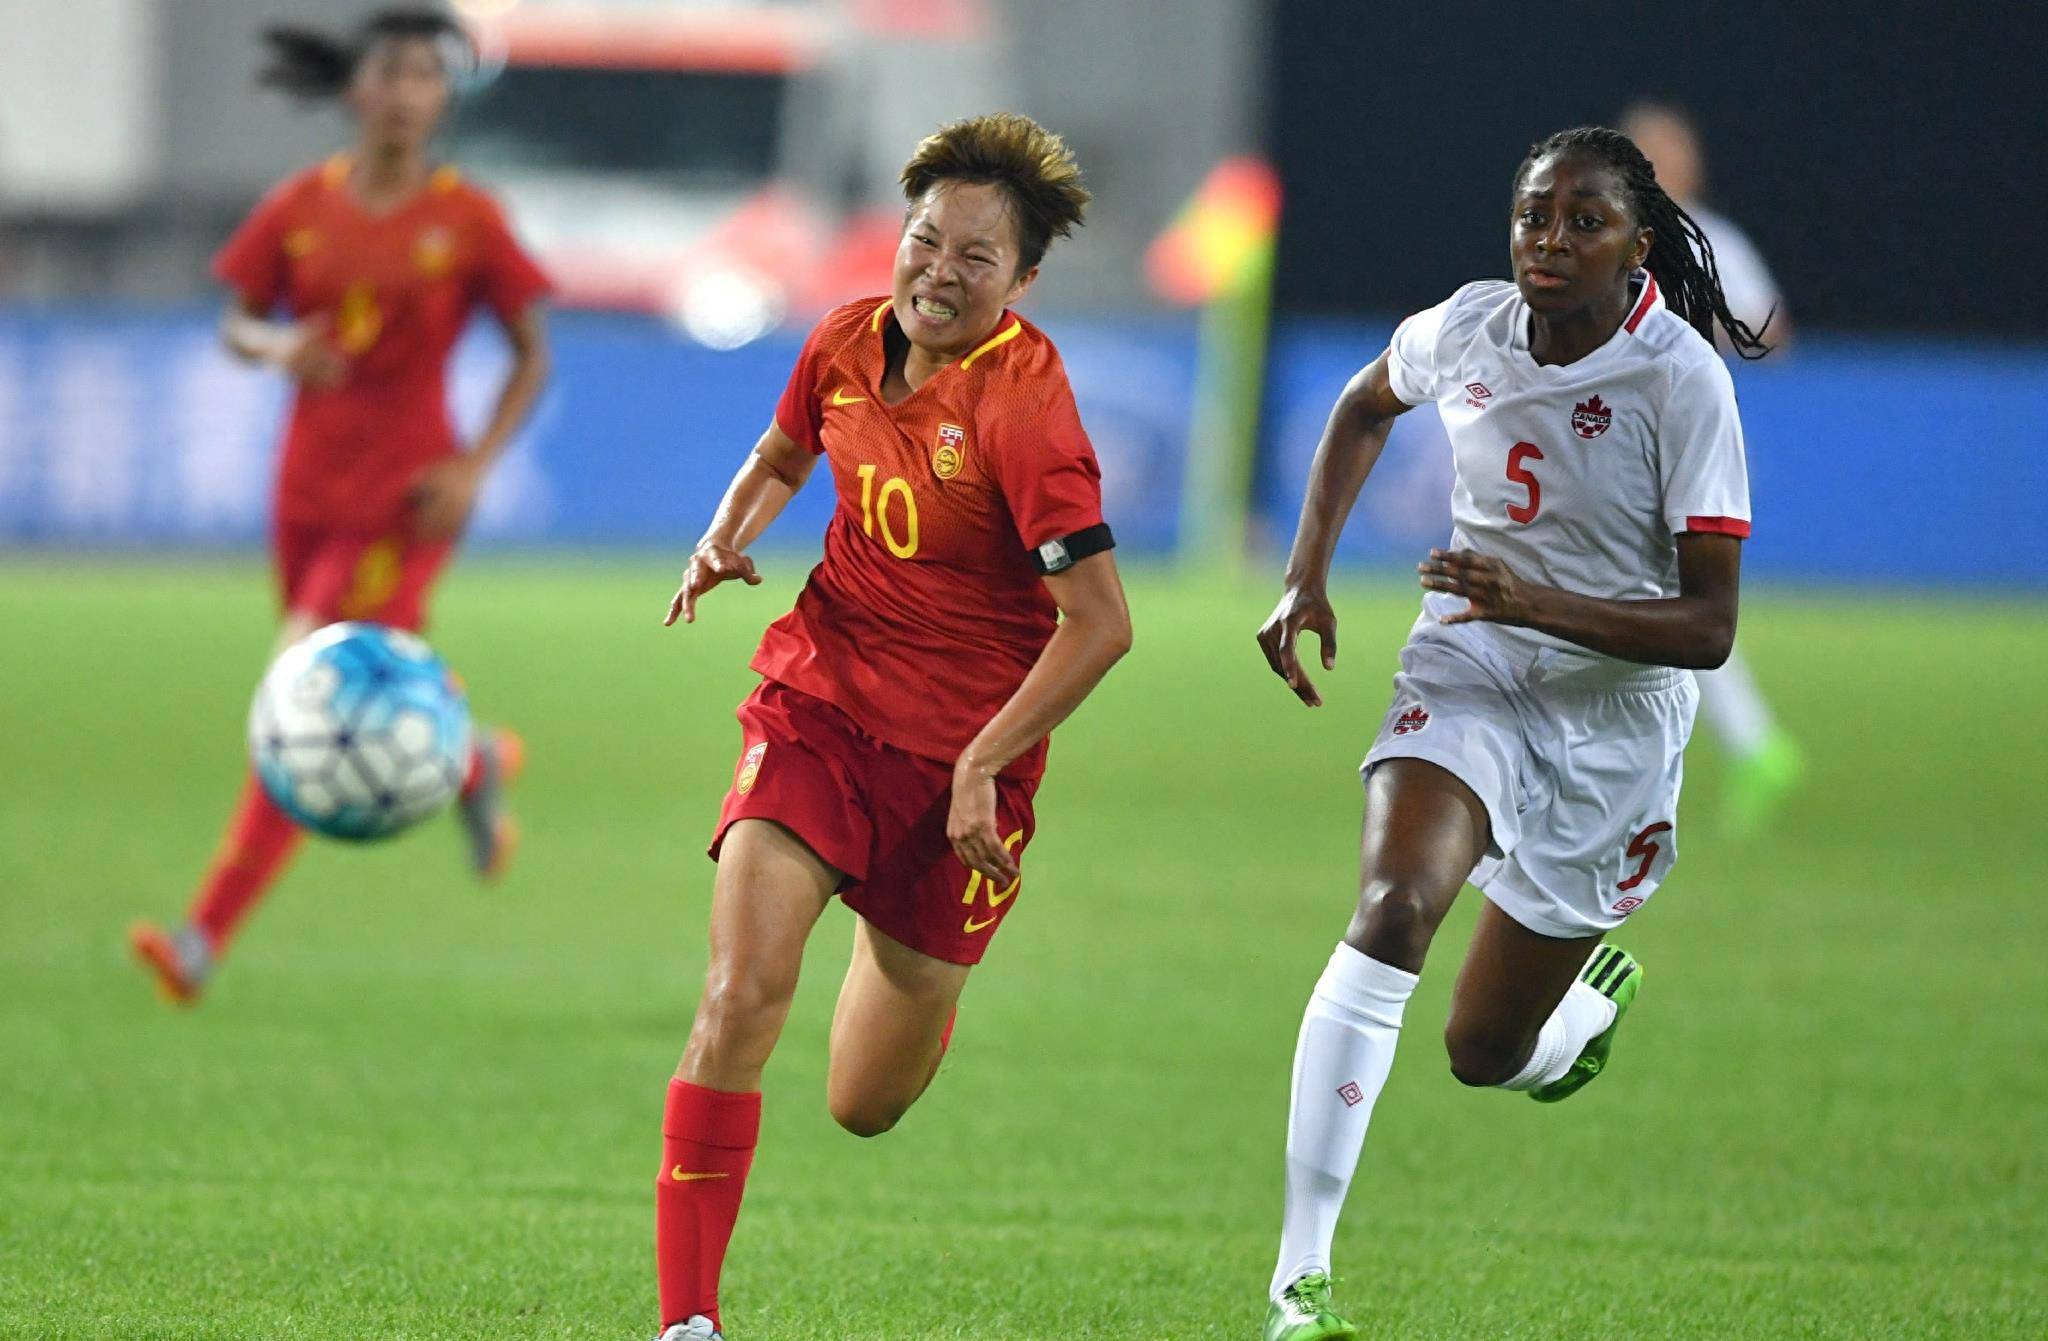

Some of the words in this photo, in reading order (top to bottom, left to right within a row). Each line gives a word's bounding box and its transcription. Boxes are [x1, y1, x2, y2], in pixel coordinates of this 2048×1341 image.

[1572, 412, 1611, 424] CANADA
[857, 464, 919, 558] 10
[1506, 441, 1544, 524] 5
[1617, 821, 1672, 891] 5
